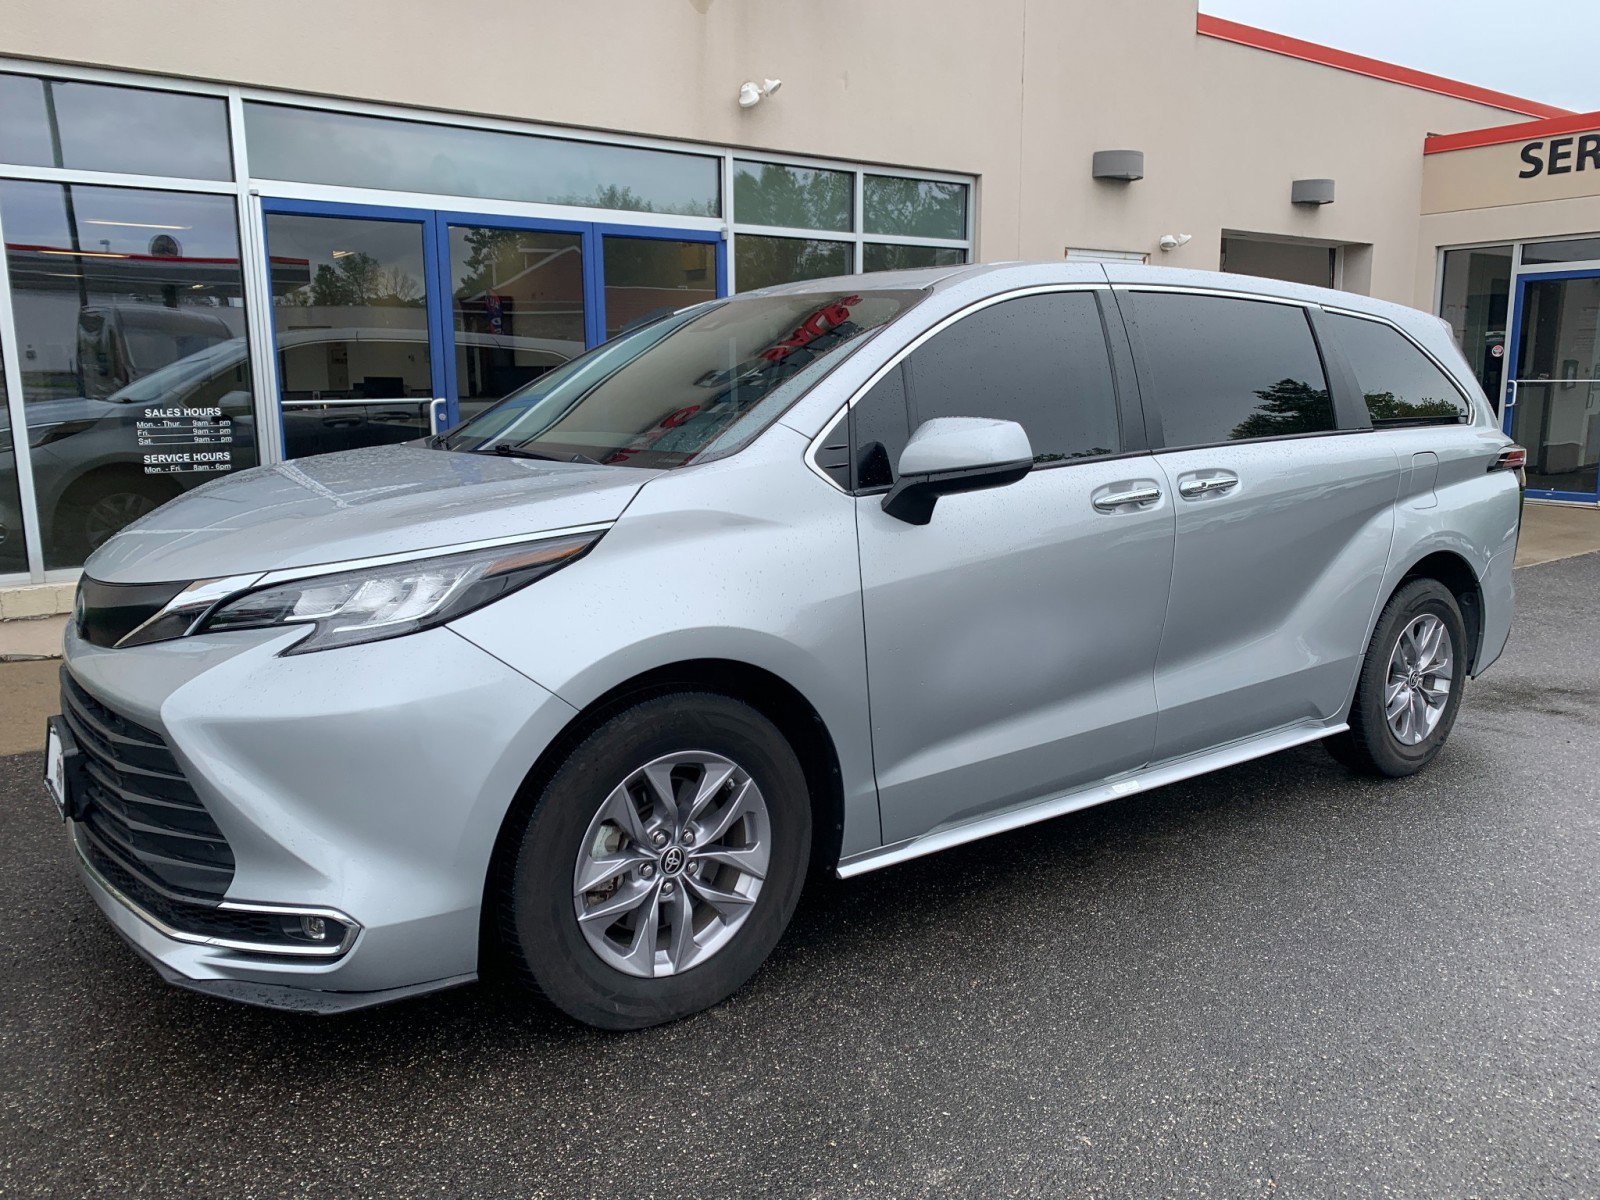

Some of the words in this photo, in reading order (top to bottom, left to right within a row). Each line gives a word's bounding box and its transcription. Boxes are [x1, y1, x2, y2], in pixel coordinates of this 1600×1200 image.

[145, 409, 180, 417] SALES
[184, 408, 221, 416] HOURS
[144, 454, 190, 463] SERVICE
[193, 452, 230, 460] HOURS
